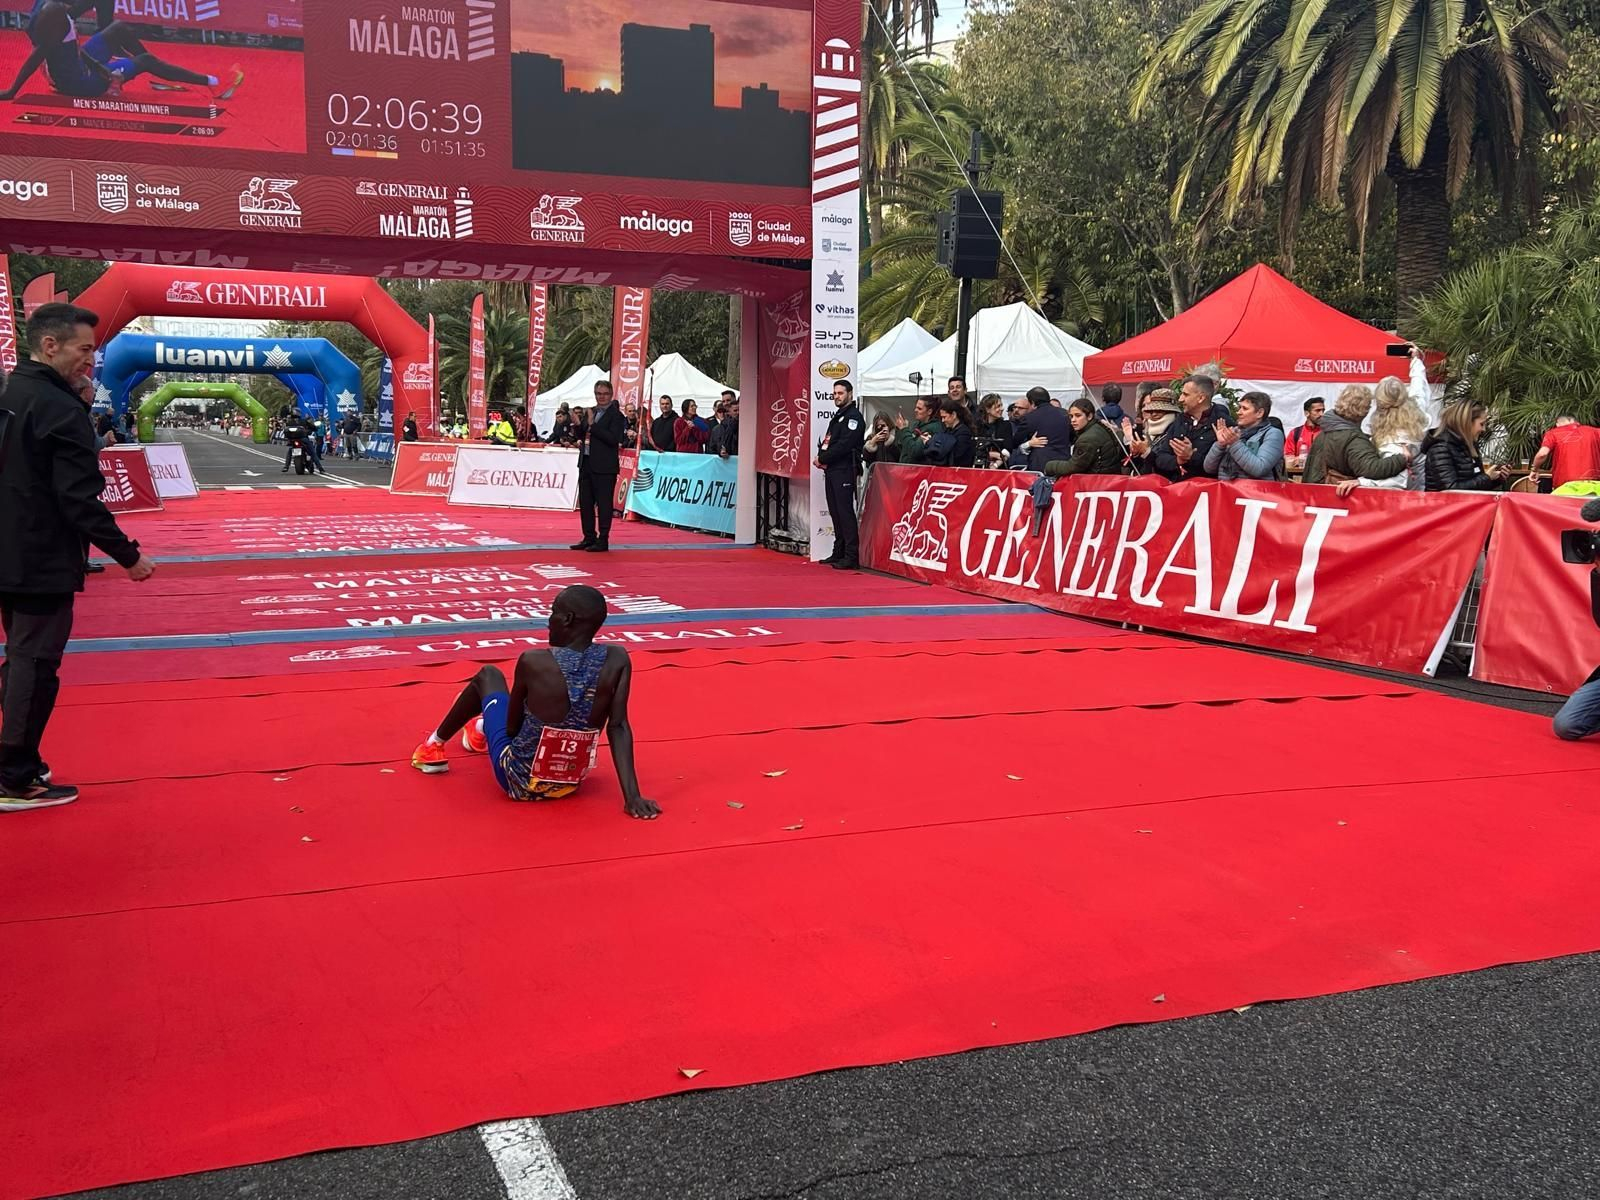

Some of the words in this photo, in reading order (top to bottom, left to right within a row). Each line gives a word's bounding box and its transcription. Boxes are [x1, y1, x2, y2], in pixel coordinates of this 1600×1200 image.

[402, 6, 455, 24] MARATÓN
[350, 15, 460, 61] MÁLAGA
[73, 98, 97, 110] MEN'S
[98, 100, 140, 113] MARATHON
[140, 104, 170, 116] WINNER
[328, 94, 482, 134] 02:06:39
[69, 118, 77, 126] 13
[192, 126, 215, 136] 2:06:05
[326, 131, 397, 150] 02:01:36
[421, 138, 486, 158] 01:51:35
[0, 180, 48, 200] aga
[136, 183, 180, 196] Ciudad
[378, 183, 448, 200] GENERALI
[136, 197, 152, 208] de
[155, 198, 200, 211] Málaga
[413, 205, 448, 216] MARATÓN
[240, 214, 302, 228] GENERALI
[380, 212, 451, 238] MÁLAGA
[757, 220, 791, 232] Ciudad
[530, 230, 585, 242] GENERALI
[758, 232, 770, 242] de
[772, 233, 805, 246] Málaga
[206, 284, 327, 308] GENERALI
[828, 305, 854, 314] vithas
[528, 282, 546, 387] GENERALI
[619, 286, 644, 382] GENERA
[815, 330, 854, 340] BYD
[155, 342, 254, 366] luanvi
[815, 342, 842, 350] Caetano
[843, 342, 854, 350] Tec
[1134, 358, 1172, 373] GENERALI
[1314, 360, 1375, 374] GENERALI
[814, 390, 834, 400] Vita
[818, 411, 838, 419] POW
[427, 470, 452, 487] MÁLA
[490, 470, 567, 490] GENERALI
[656, 476, 704, 504] WORLD
[702, 479, 736, 509] ATHL
[959, 484, 1348, 634] GENERALI
[560, 740, 578, 753] 13
